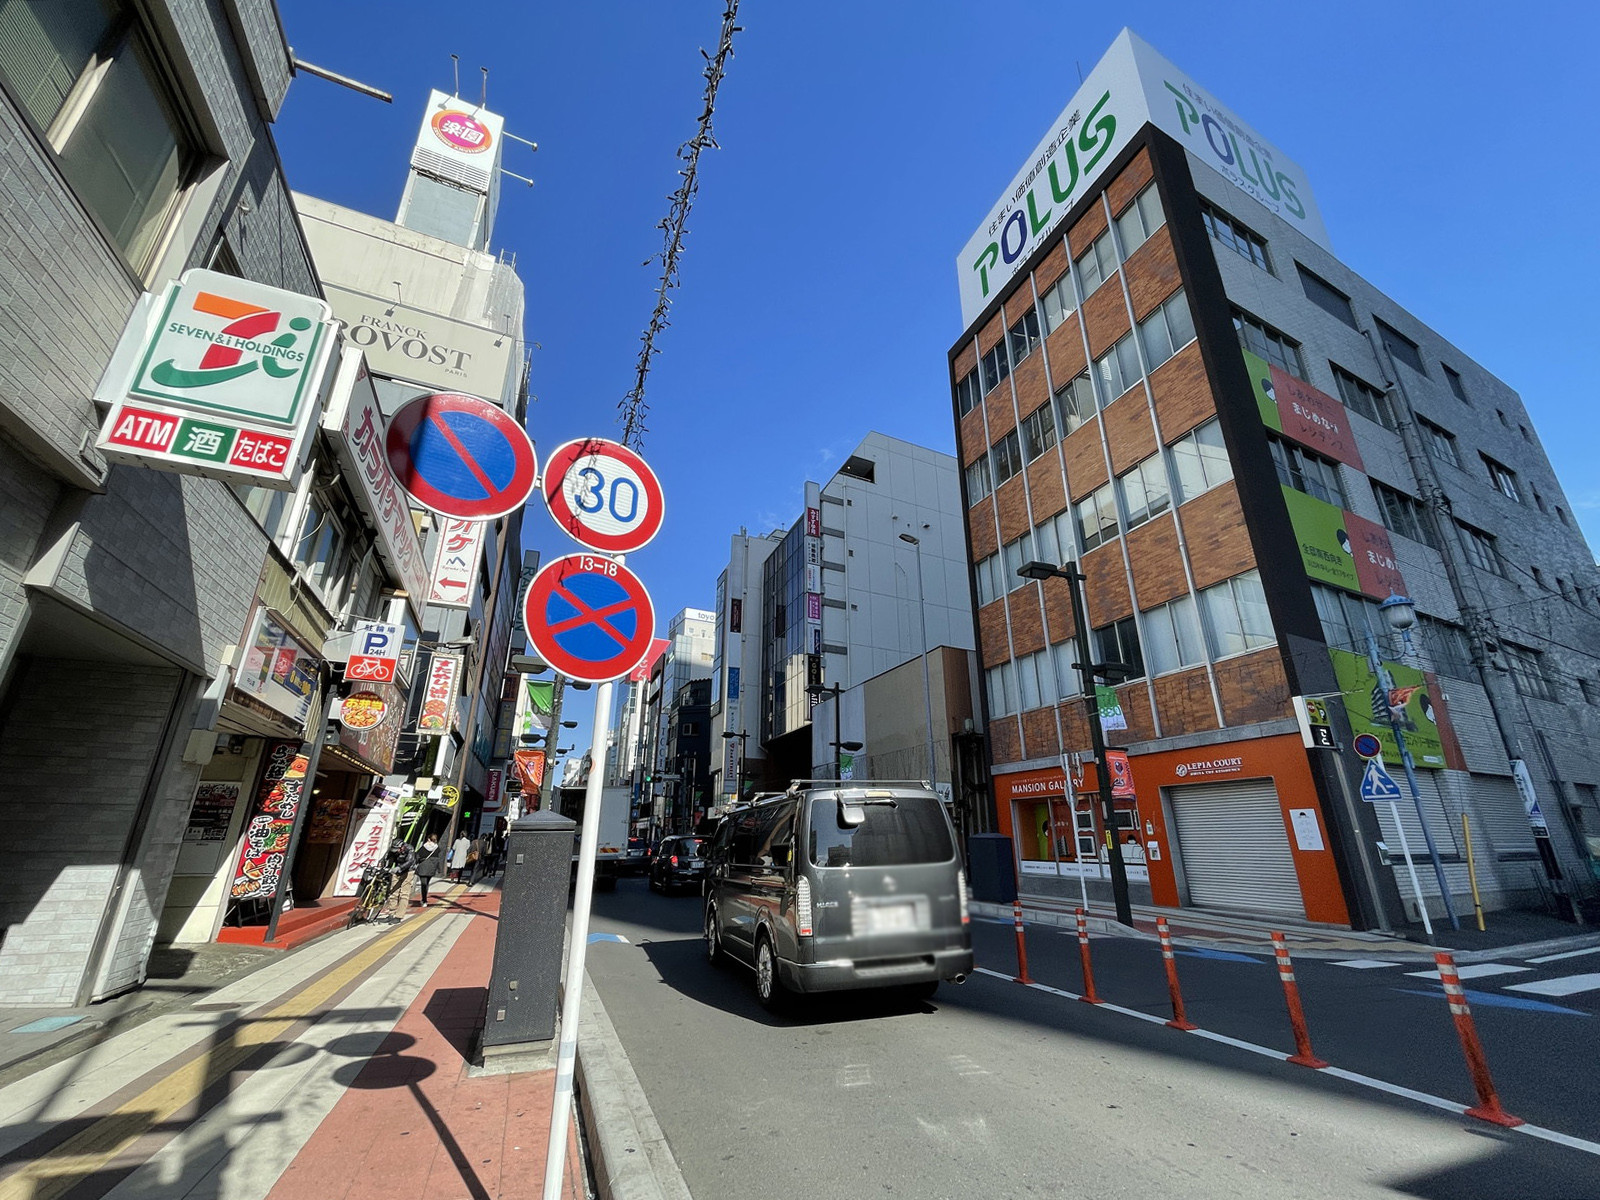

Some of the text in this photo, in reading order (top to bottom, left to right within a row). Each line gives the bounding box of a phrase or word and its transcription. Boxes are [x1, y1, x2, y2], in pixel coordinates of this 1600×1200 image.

[441, 120, 484, 145] 楽園
[1164, 80, 1306, 220] POLUS
[988, 109, 1082, 237] 住まい価値創造企業
[973, 89, 1117, 298] POLUS
[360, 314, 428, 341] FRANCK
[234, 339, 305, 362] HOLDINGS
[444, 368, 468, 379] PARIS
[114, 414, 174, 447] ATM
[182, 426, 225, 456] 酒
[232, 436, 287, 467] たばこ
[574, 466, 641, 524] 30
[578, 556, 619, 578] 13-18
[363, 633, 388, 654] P
[365, 624, 396, 634] 駐輪場
[369, 648, 386, 656] 24H
[345, 698, 383, 711] お弁当
[1187, 757, 1242, 770] LEPIA COURT
[489, 771, 497, 801] RAKUEN
[1012, 782, 1046, 793] MANSION
[248, 824, 272, 859] 油そば
[347, 841, 366, 872] マック
[364, 825, 383, 866] カラオケ
[261, 852, 284, 896] 肉汁餃子
